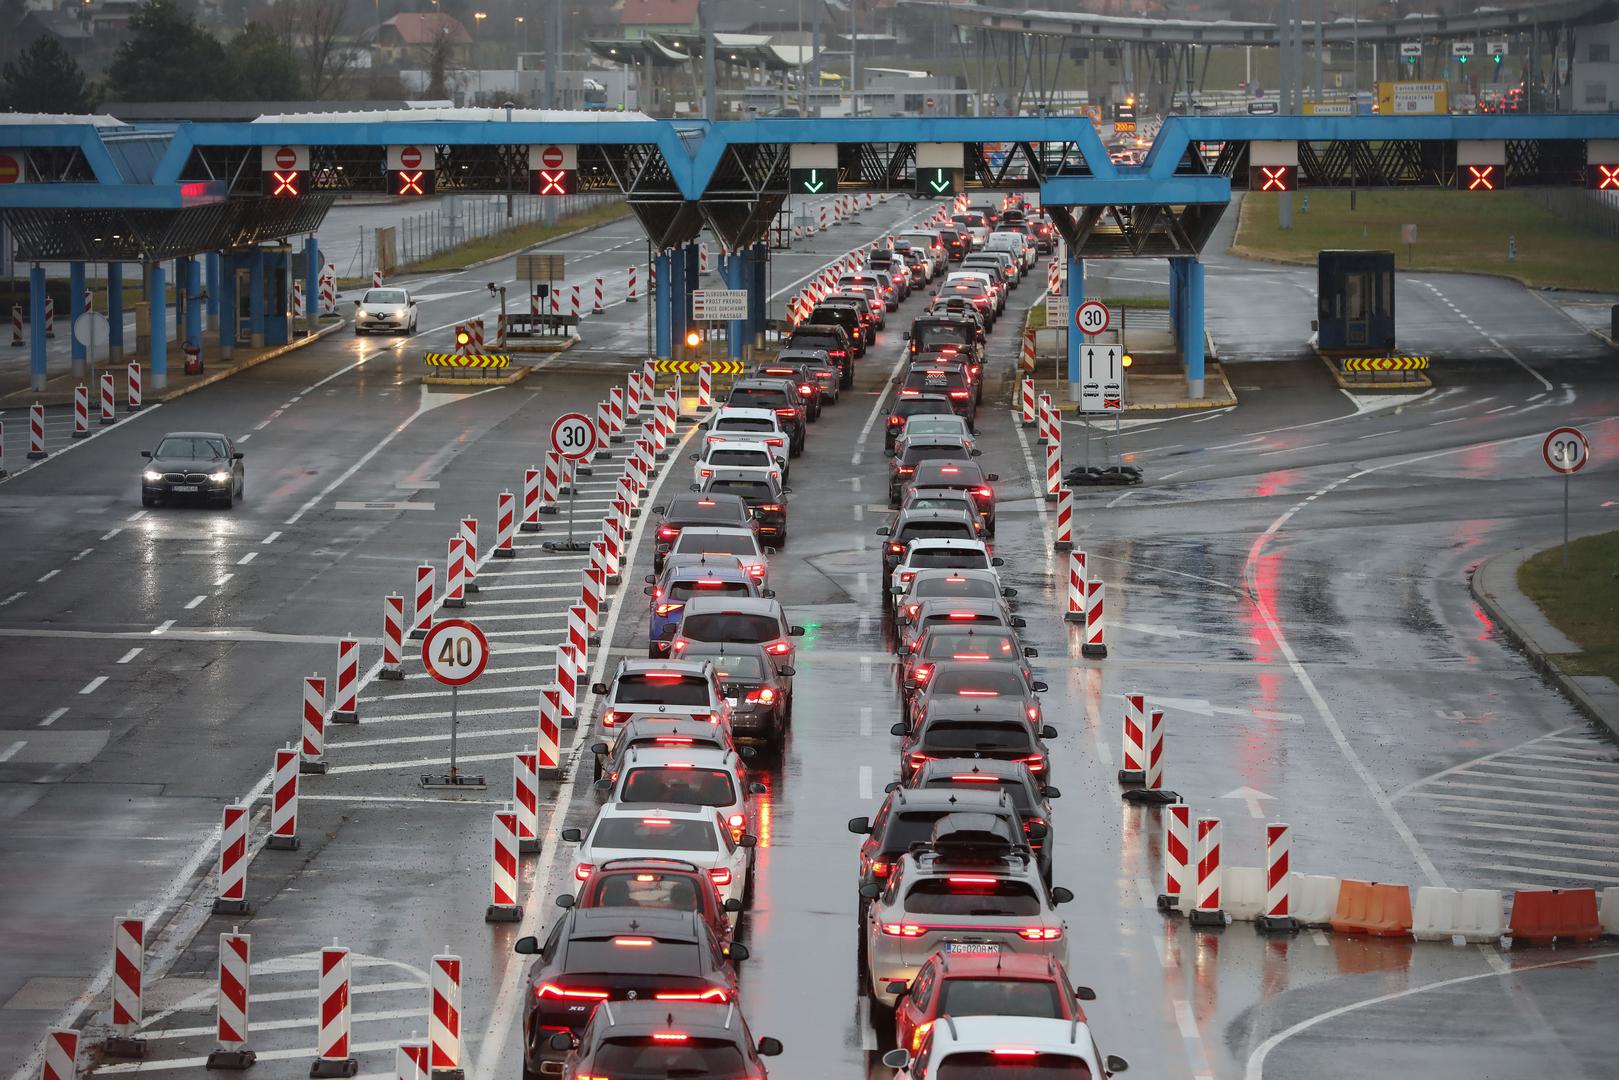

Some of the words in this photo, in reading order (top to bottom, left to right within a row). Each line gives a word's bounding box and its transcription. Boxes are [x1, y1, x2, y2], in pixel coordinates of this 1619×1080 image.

[1084, 310, 1102, 326] 30
[562, 426, 586, 447] 30
[1554, 440, 1578, 462] 30
[438, 636, 472, 667] 40
